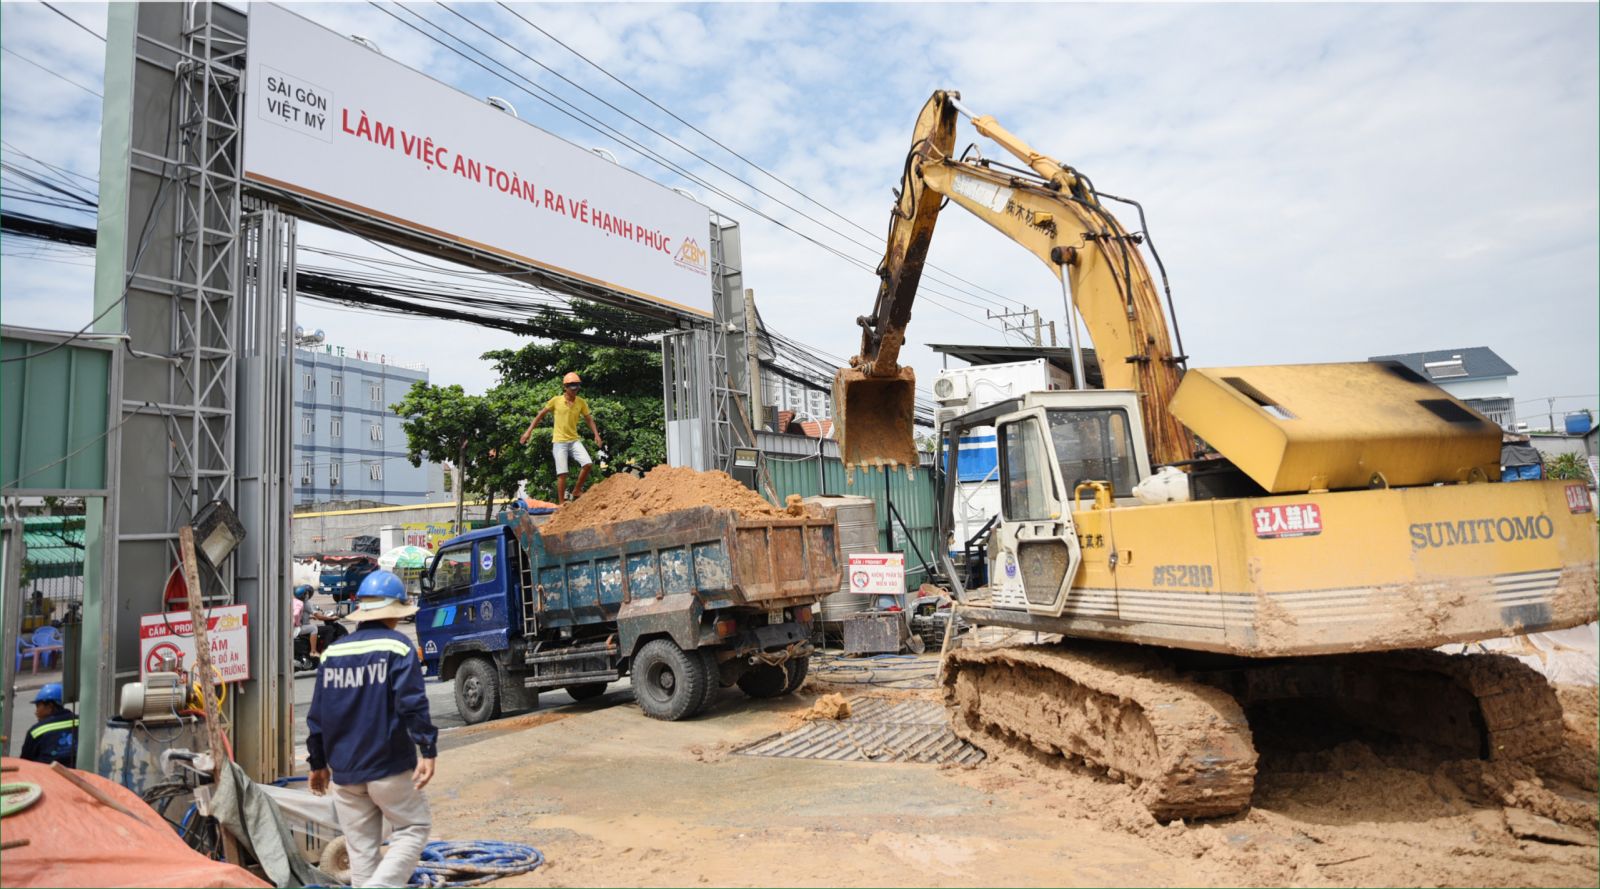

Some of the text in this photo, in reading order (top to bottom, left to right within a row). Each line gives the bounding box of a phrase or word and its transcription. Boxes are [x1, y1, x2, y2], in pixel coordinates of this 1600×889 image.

[267, 77, 327, 111] SÀI GÒN
[267, 97, 326, 131] VIỆT MỸ
[342, 108, 671, 255] LÀM VIỆC AN TOÀN, RA VỀ HẠNH PHÚC
[1255, 504, 1320, 533] 立入禁止
[1409, 514, 1555, 550] SUMITOMO
[148, 625, 165, 637] CẤM
[323, 658, 388, 689] PHAN VŨ
